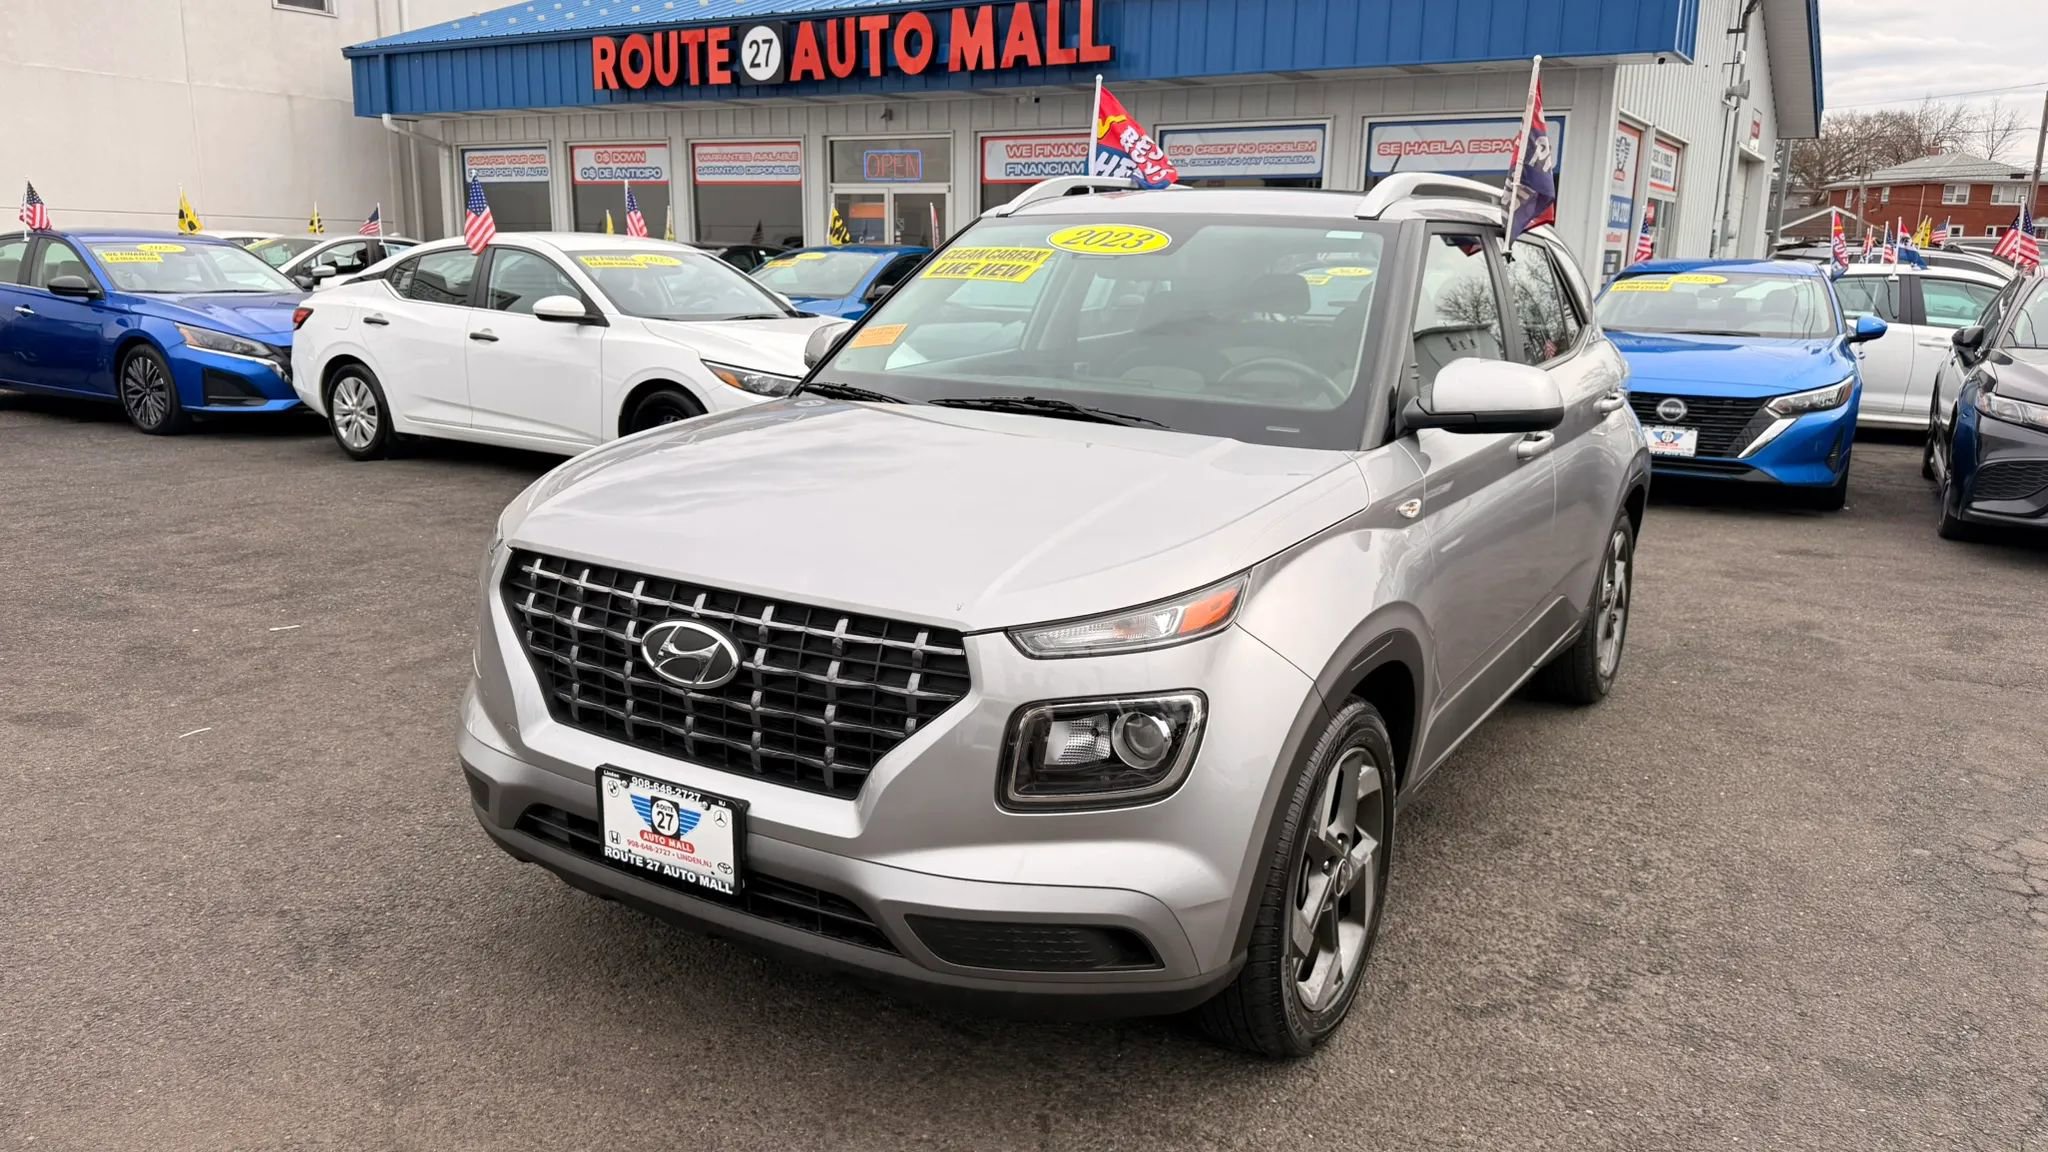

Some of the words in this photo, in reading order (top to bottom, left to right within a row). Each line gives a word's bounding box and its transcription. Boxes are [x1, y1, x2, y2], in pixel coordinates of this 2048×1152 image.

[592, 26, 732, 90] ROUTE
[748, 38, 774, 69] 27
[789, 11, 934, 81] AUTO
[948, 0, 1111, 72] MALL
[1006, 144, 1032, 158] WE
[1033, 143, 1089, 158] FINANC
[1168, 145, 1193, 156] BAD
[1195, 144, 1237, 155] CREDIT
[1238, 143, 1259, 154] NO
[1259, 141, 1317, 153] PROBLEM
[1377, 141, 1402, 156] SE
[1403, 139, 1465, 155] HABLA
[1467, 138, 1516, 154] ESPA
[468, 156, 488, 165] CASH
[488, 155, 505, 165] FOR
[506, 155, 528, 164] YOUR
[529, 154, 546, 164] CAR
[611, 151, 646, 164] DOWN
[1190, 157, 1226, 166] CREDITO
[1263, 155, 1316, 165] PROBLEMA
[468, 168, 495, 177] DNERO
[495, 167, 512, 176] POR
[513, 167, 525, 176] TU
[525, 167, 549, 176] AUTO
[745, 165, 801, 175] DISPONIBLES
[866, 153, 919, 178] OPEN
[1005, 162, 1085, 176] FINANCIAM
[598, 168, 613, 179] DE
[614, 167, 663, 180] ANTICIPO
[1063, 229, 1154, 249] 2023
[943, 249, 989, 262] CLEAN
[985, 249, 1050, 263] CARFAX
[930, 262, 981, 277] LIKE
[973, 262, 1030, 278] NEW
[631, 776, 701, 803] 908-648-2727
[656, 802, 674, 812] ROUTE
[656, 810, 674, 831] 27
[627, 838, 671, 857] 908-648-2727
[643, 832, 666, 845] AUTO
[668, 836, 692, 853] MALL
[604, 846, 644, 867] ROUTE
[646, 859, 660, 872] 27
[663, 865, 697, 883] AUTO
[699, 874, 734, 895] MALL
